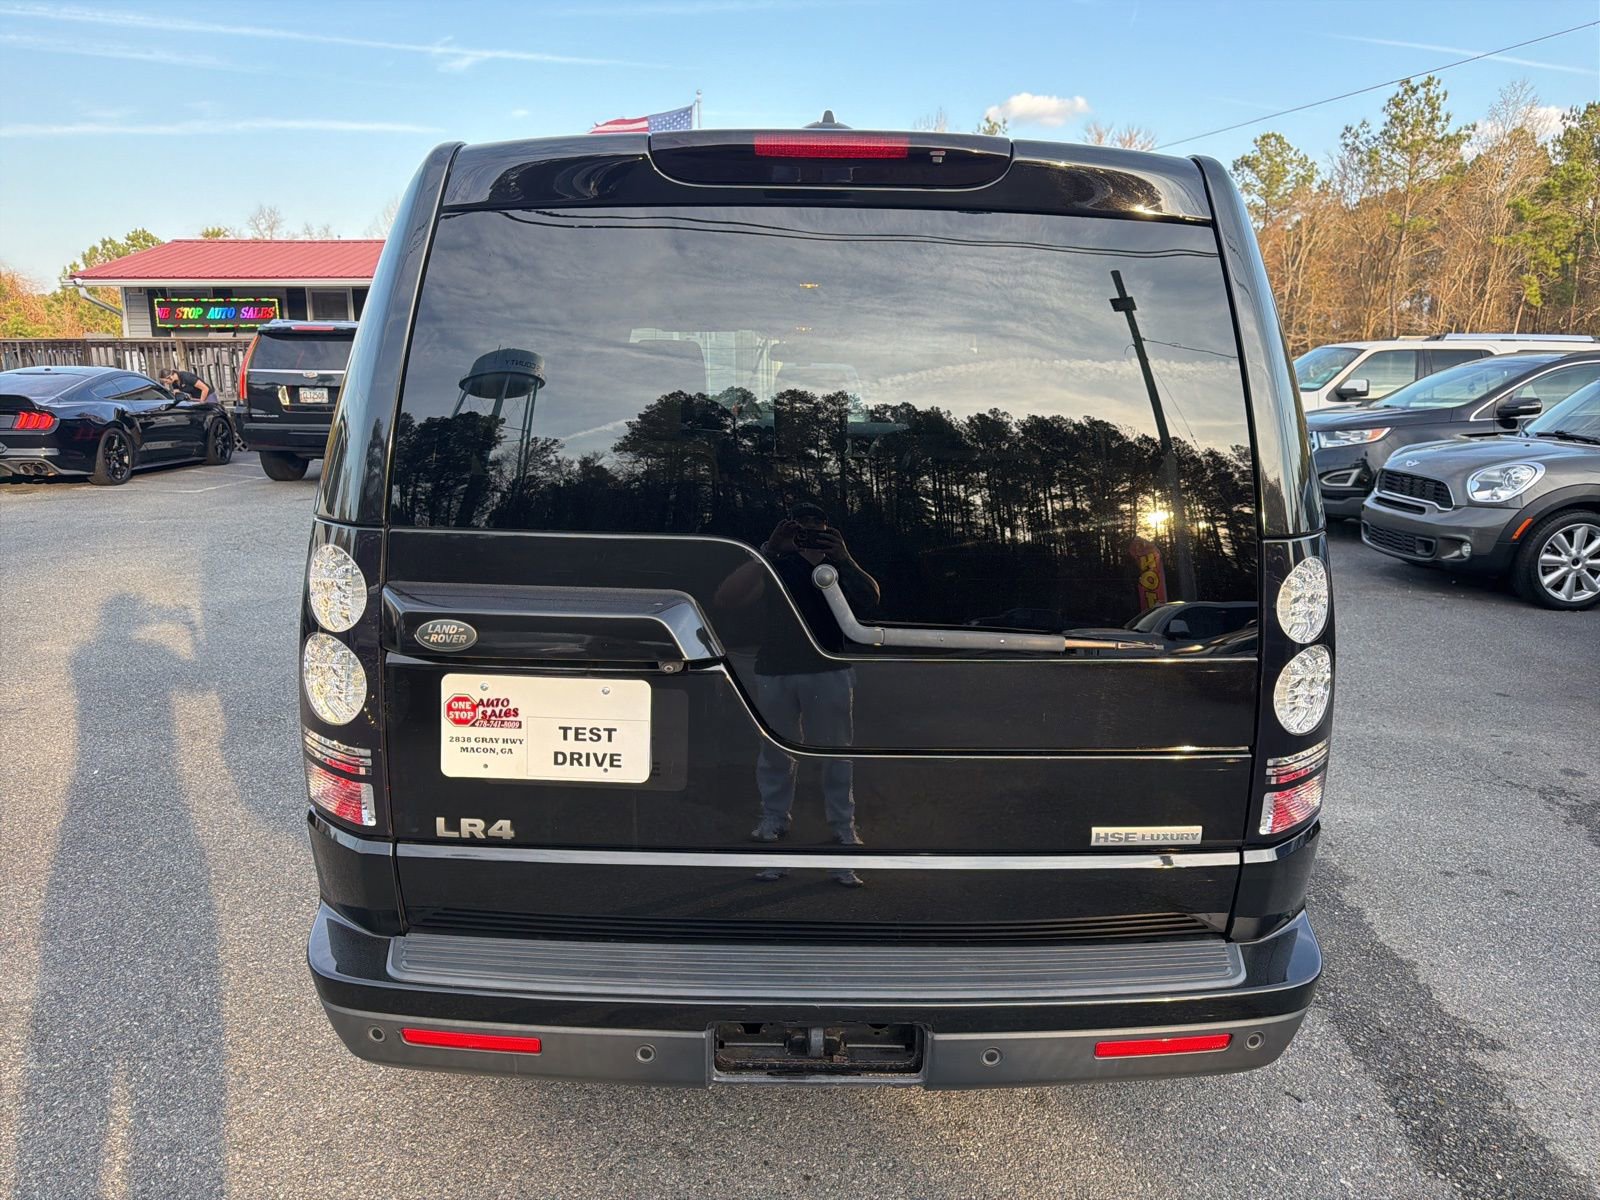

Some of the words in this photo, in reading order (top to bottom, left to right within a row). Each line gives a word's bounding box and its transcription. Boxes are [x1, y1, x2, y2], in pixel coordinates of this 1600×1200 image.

[175, 306, 204, 319] STOP
[207, 306, 237, 319] AUTO
[240, 306, 275, 319] SALES
[428, 624, 458, 634] LAND
[430, 634, 467, 643] ROVER
[451, 701, 472, 710] ONE
[476, 698, 510, 708] AUTO
[448, 711, 474, 720] STOP
[558, 726, 618, 742] TEST
[449, 735, 472, 743] 2838
[474, 736, 500, 744] GRAY
[460, 746, 499, 755] MACON,
[553, 751, 622, 768] DRIVE
[435, 816, 515, 840] LR4
[1095, 832, 1138, 843] HSE
[1141, 832, 1200, 841] LUXURY
